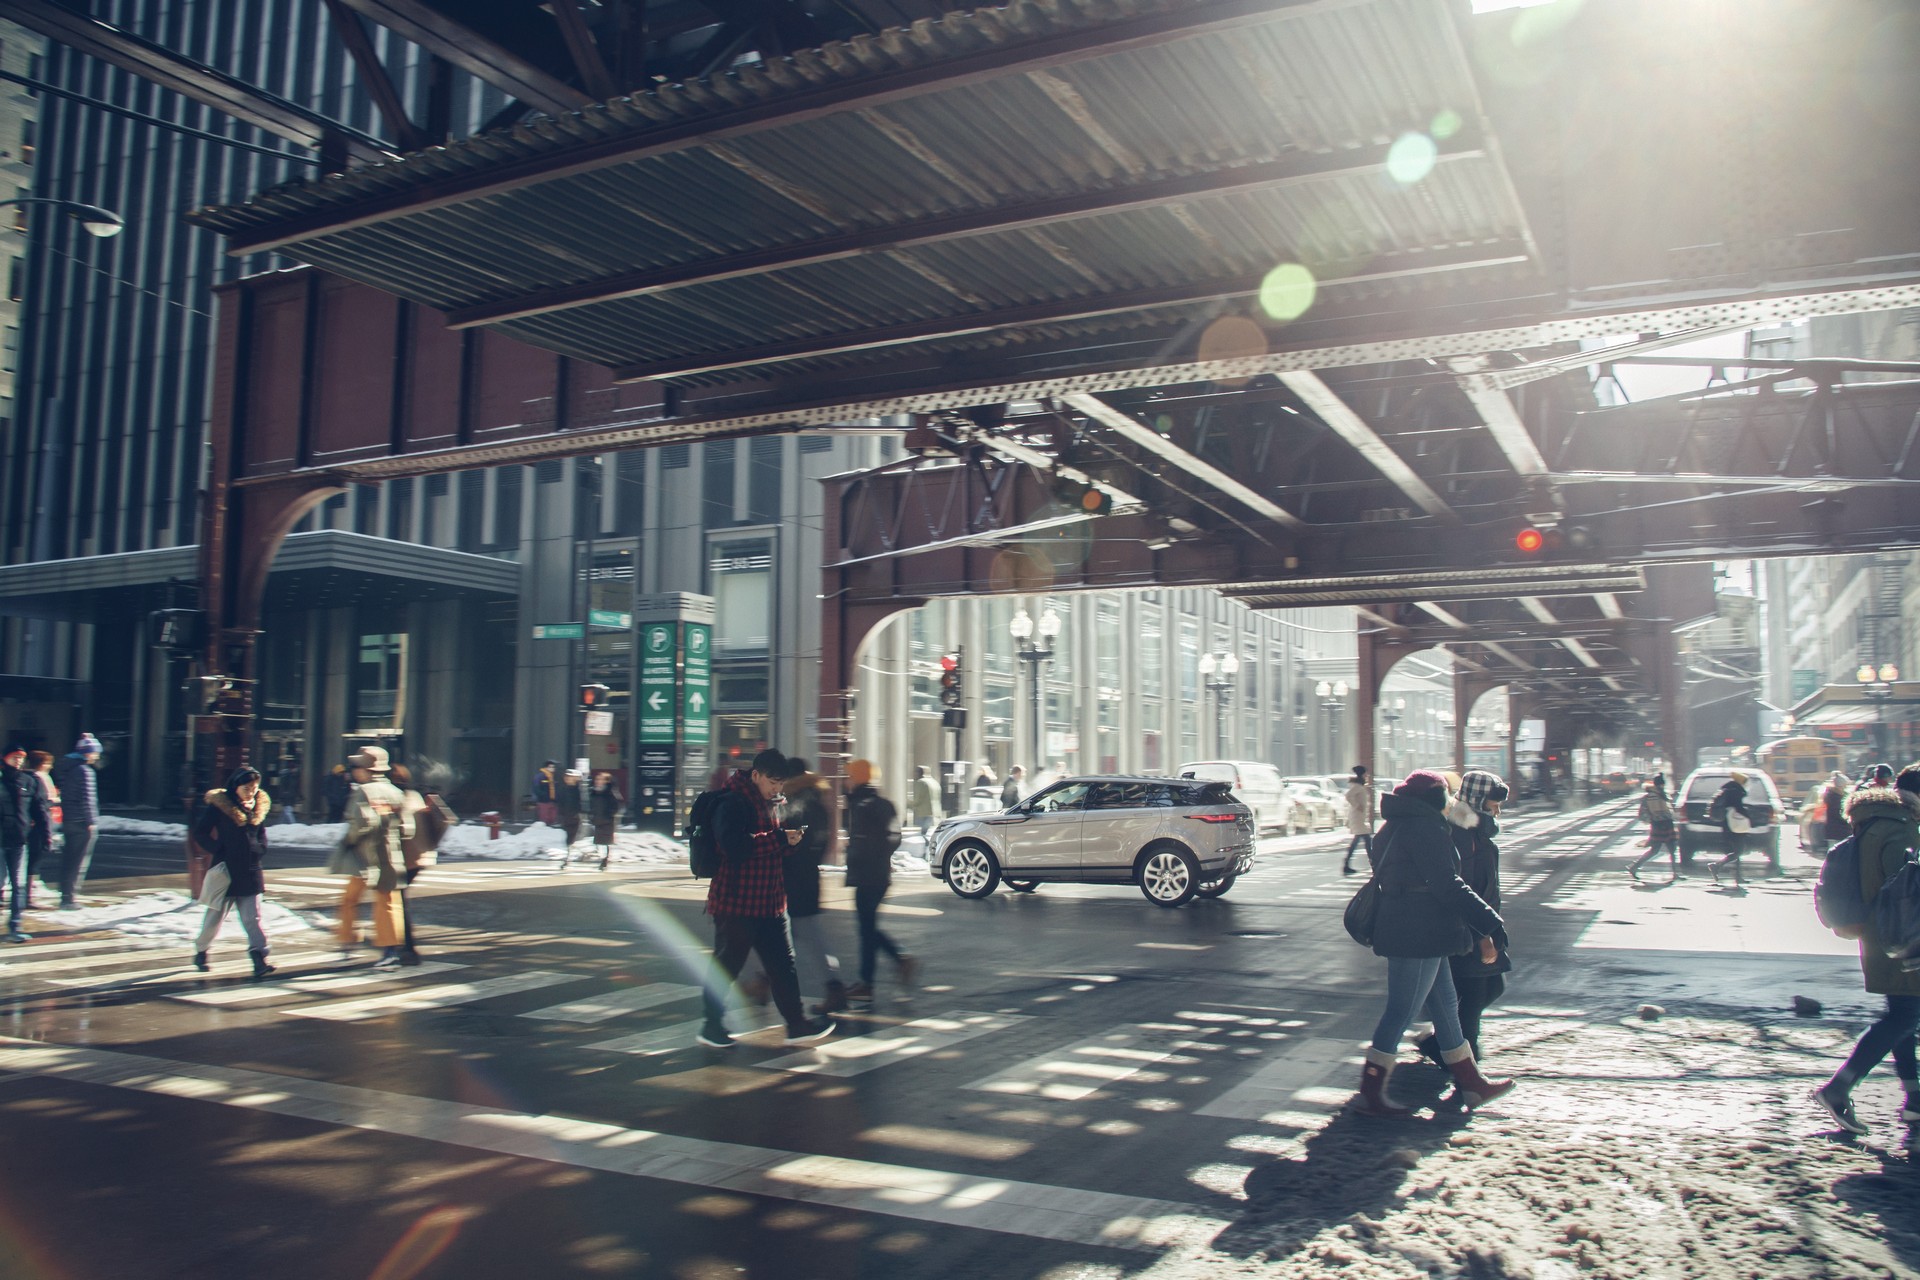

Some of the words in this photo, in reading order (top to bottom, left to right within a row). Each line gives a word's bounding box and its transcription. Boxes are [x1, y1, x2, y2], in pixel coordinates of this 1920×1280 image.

[653, 631, 667, 648] P
[692, 633, 704, 649] P
[641, 677, 674, 685] PARKING
